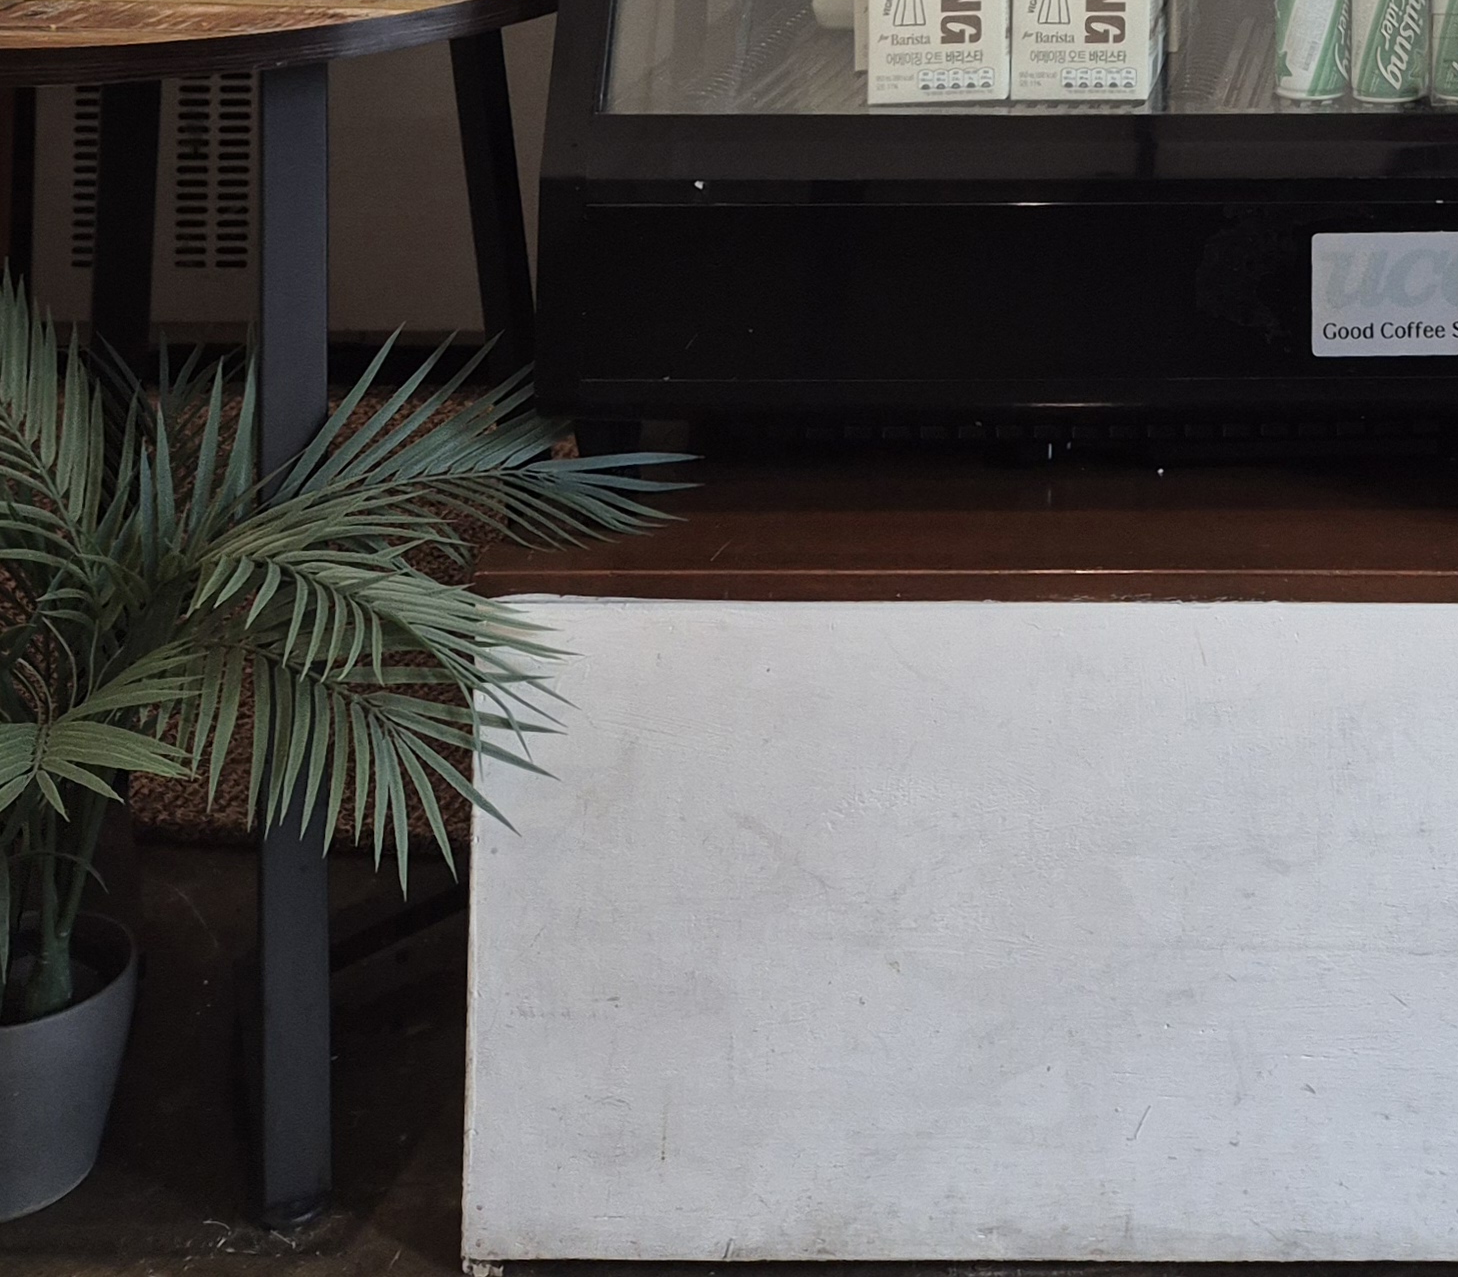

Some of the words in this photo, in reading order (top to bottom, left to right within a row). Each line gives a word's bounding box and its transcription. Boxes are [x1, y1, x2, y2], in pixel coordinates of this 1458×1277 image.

[891, 33, 932, 46] Barista
[1035, 30, 1075, 44] Barista
[924, 51, 944, 65] 오트
[945, 49, 984, 65] 바리스타
[1067, 49, 1088, 64] 오트
[1088, 49, 1127, 65] 바리스타
[1322, 322, 1375, 340] Good
[1380, 321, 1446, 339] Coffee
